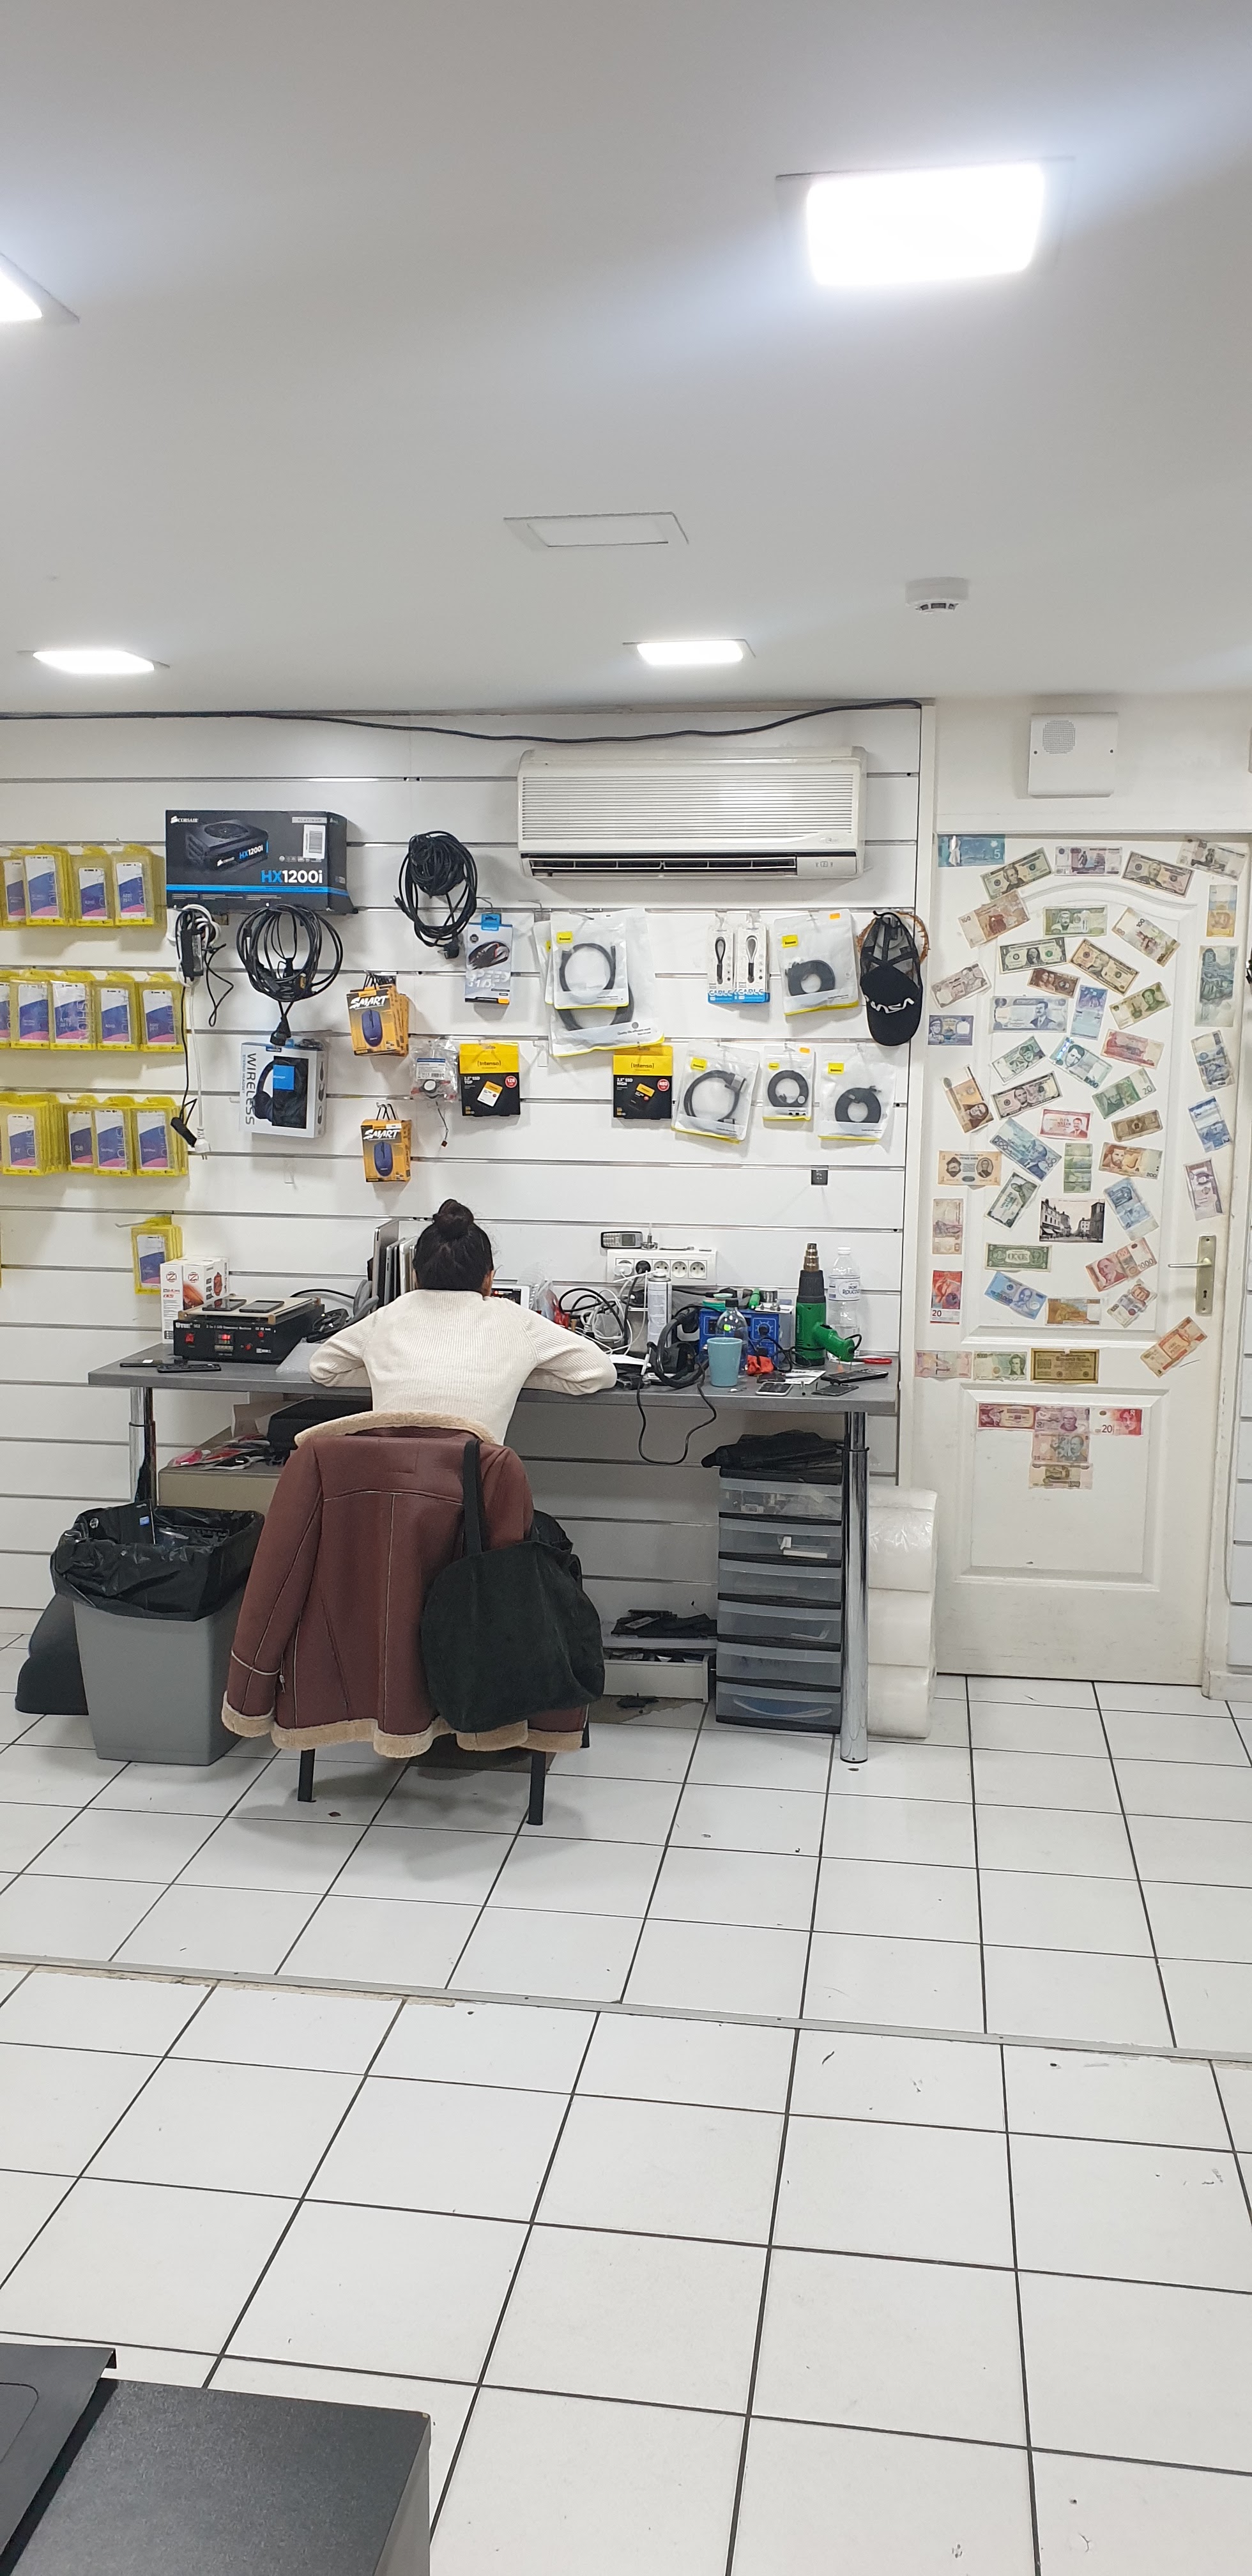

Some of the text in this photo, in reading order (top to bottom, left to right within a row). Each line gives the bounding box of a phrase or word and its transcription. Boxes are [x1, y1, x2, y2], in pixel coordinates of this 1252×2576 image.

[238, 844, 264, 860] HX1200i
[993, 848, 1001, 859] 5
[261, 870, 323, 884] HX1200i
[349, 995, 388, 1009] SMART
[245, 1053, 257, 1125] WIRELESS
[1142, 1085, 1153, 1095] 20
[363, 1129, 401, 1140] SMART
[1138, 1258, 1154, 1271] 1000
[1101, 1424, 1113, 1434] 20
